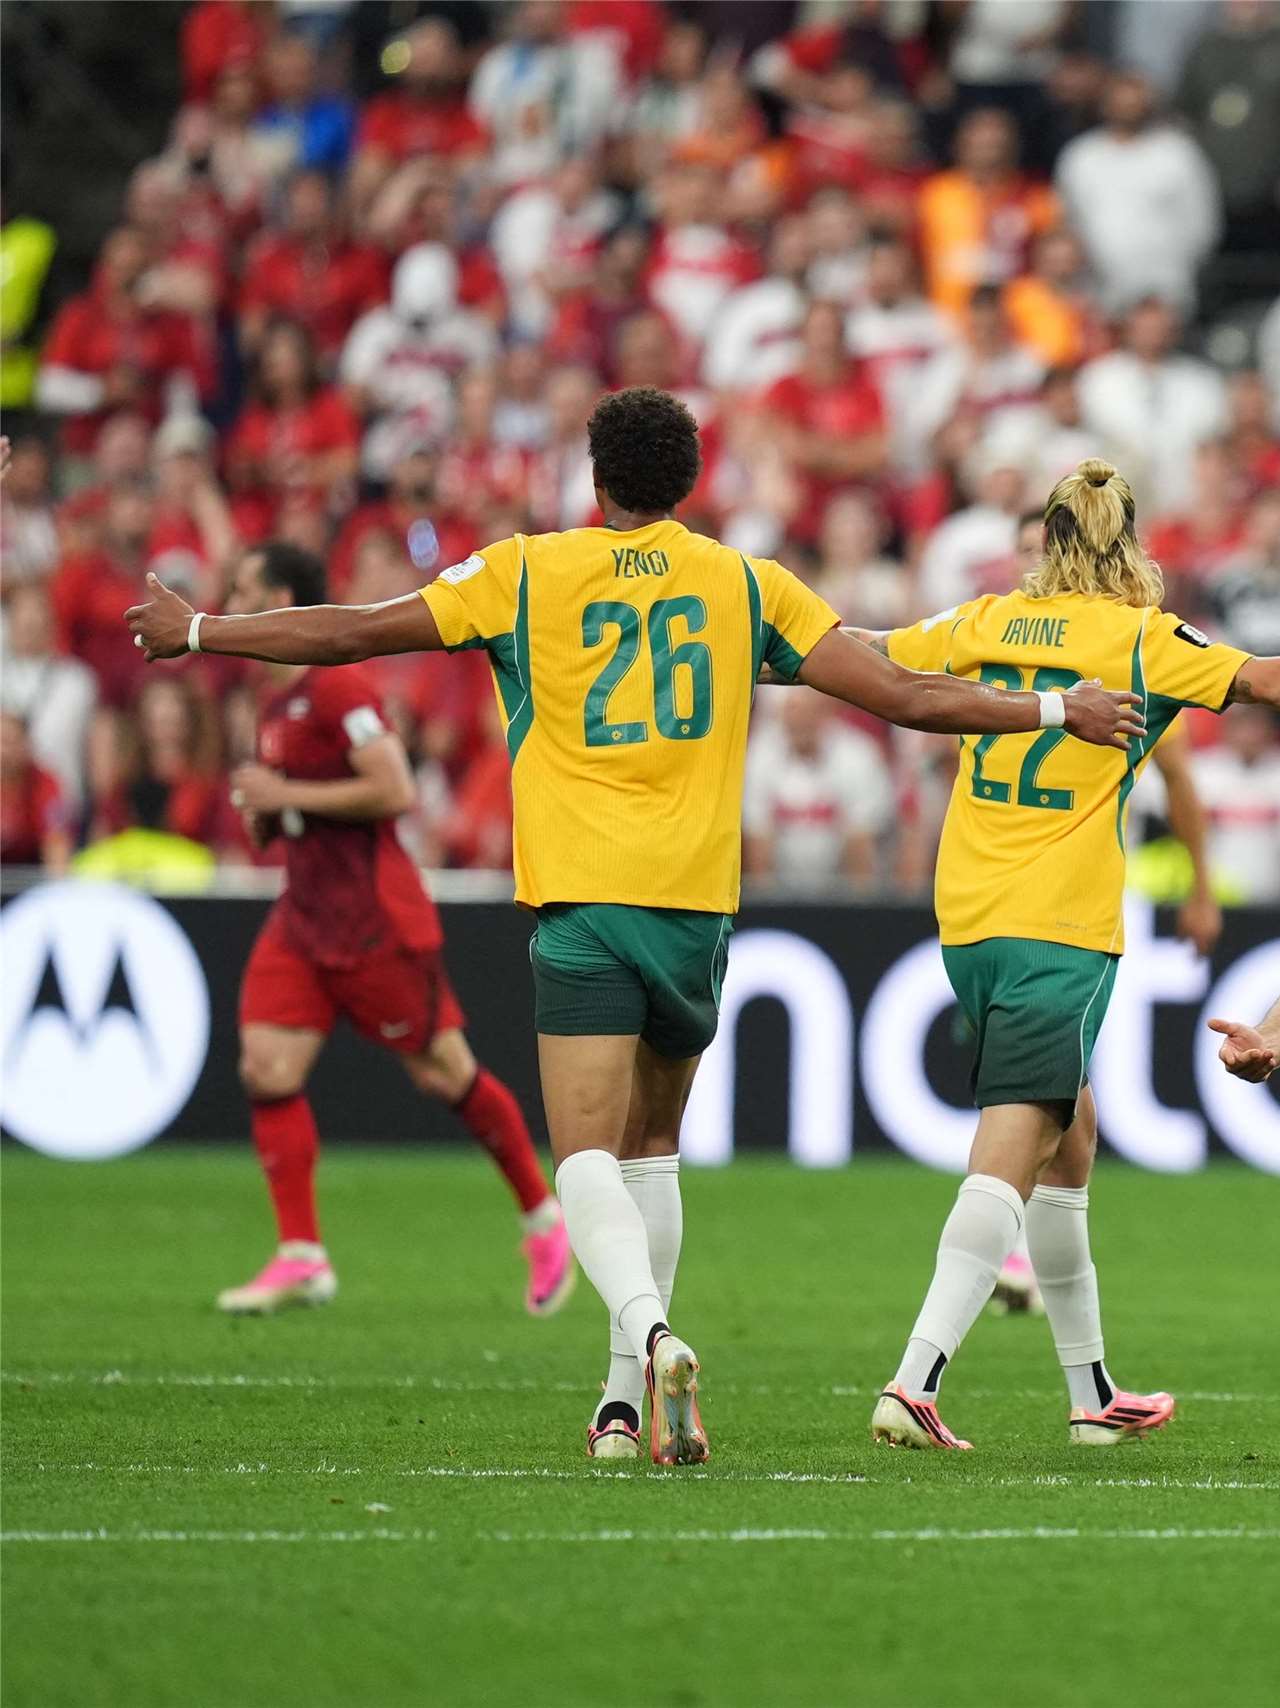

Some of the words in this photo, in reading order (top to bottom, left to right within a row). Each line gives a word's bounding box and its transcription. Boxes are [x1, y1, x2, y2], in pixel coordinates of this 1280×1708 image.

[611, 548, 670, 578] YENGI
[1000, 617, 1070, 648] IRVINE
[582, 594, 714, 747] 26
